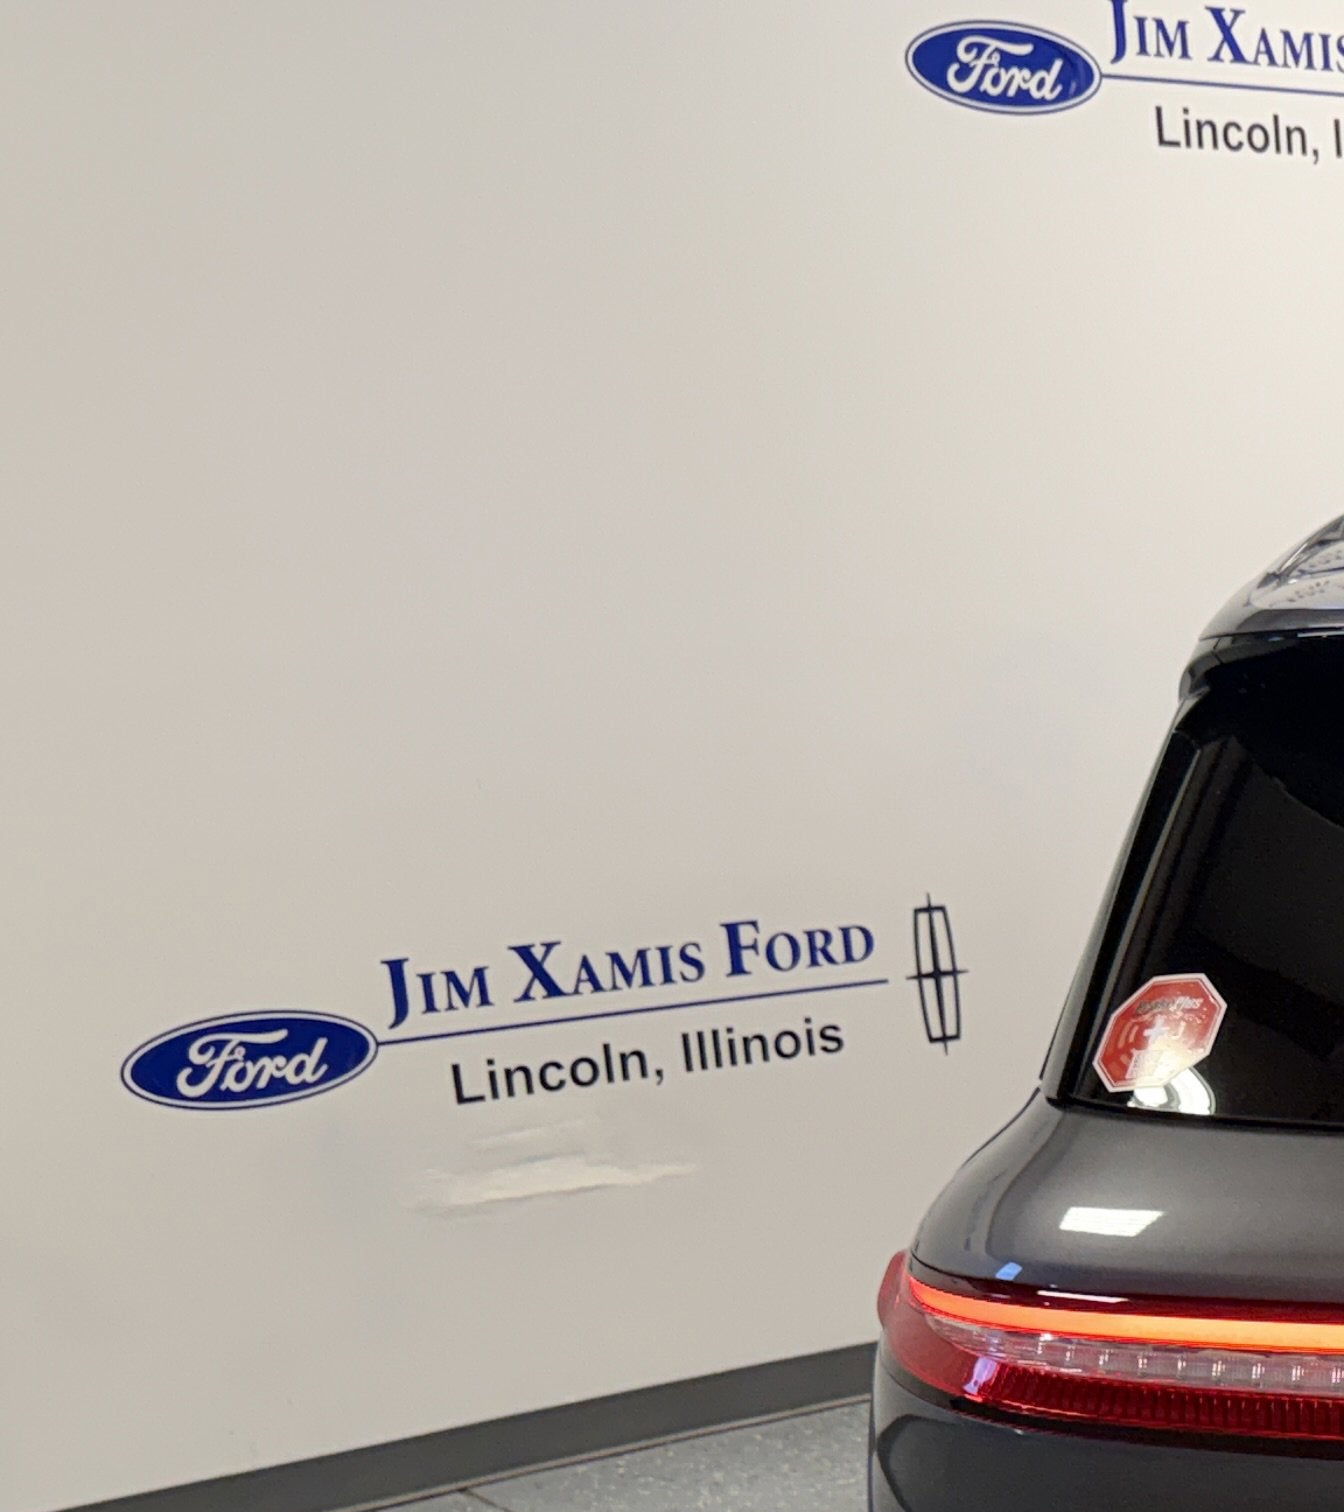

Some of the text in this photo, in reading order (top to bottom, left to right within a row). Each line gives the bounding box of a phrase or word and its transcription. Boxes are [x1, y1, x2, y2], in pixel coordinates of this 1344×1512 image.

[1109, 0, 1191, 64] JIM
[946, 35, 1064, 100] Ford
[1155, 106, 1318, 164] Lincoln,
[381, 920, 874, 1029] JIM XAMIS FORD
[176, 1028, 329, 1098] Ford
[451, 1017, 844, 1105] Lincoln, Illinois
